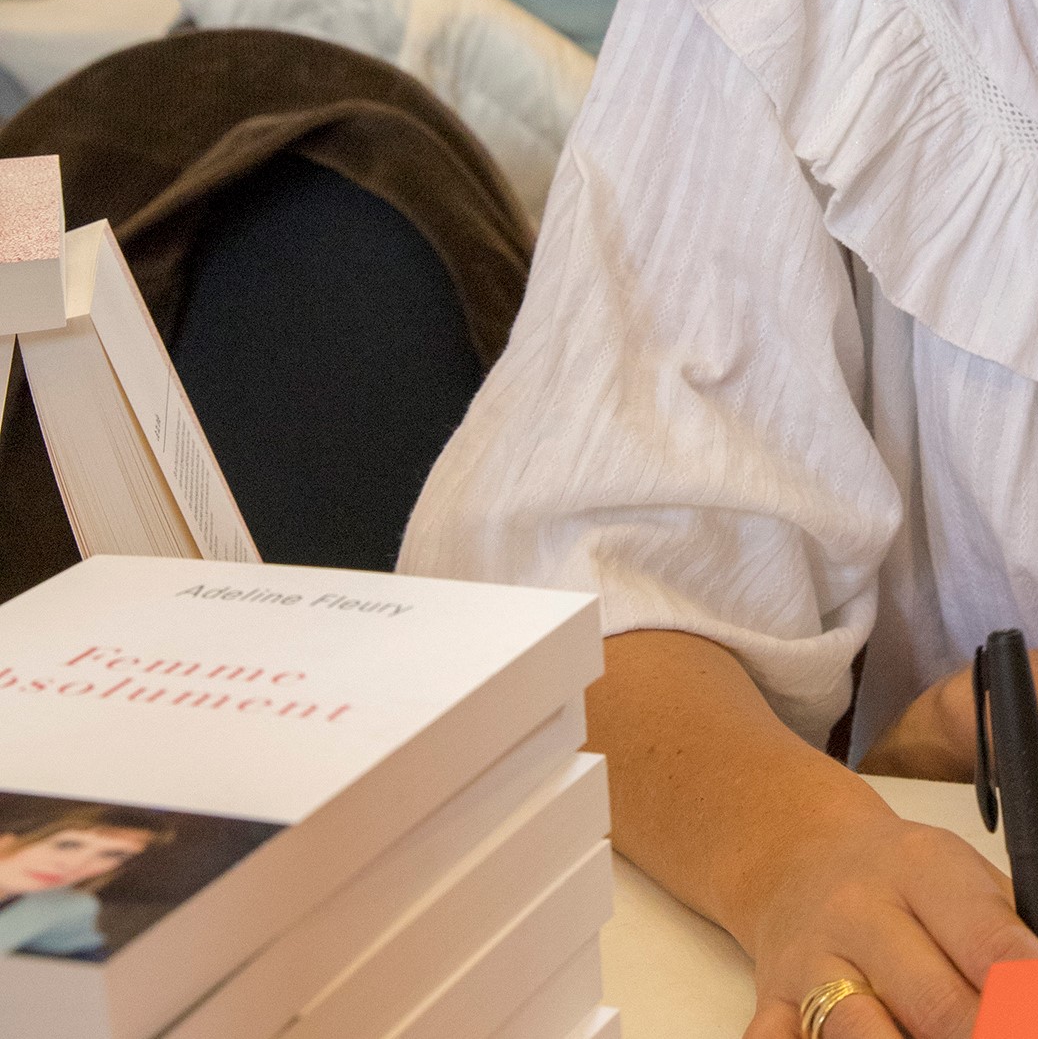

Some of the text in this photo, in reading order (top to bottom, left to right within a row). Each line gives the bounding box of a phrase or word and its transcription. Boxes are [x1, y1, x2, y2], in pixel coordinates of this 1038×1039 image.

[176, 584, 413, 618] Adeline Fleury
[65, 646, 306, 684] Femme
[0, 666, 352, 722] bsolument
